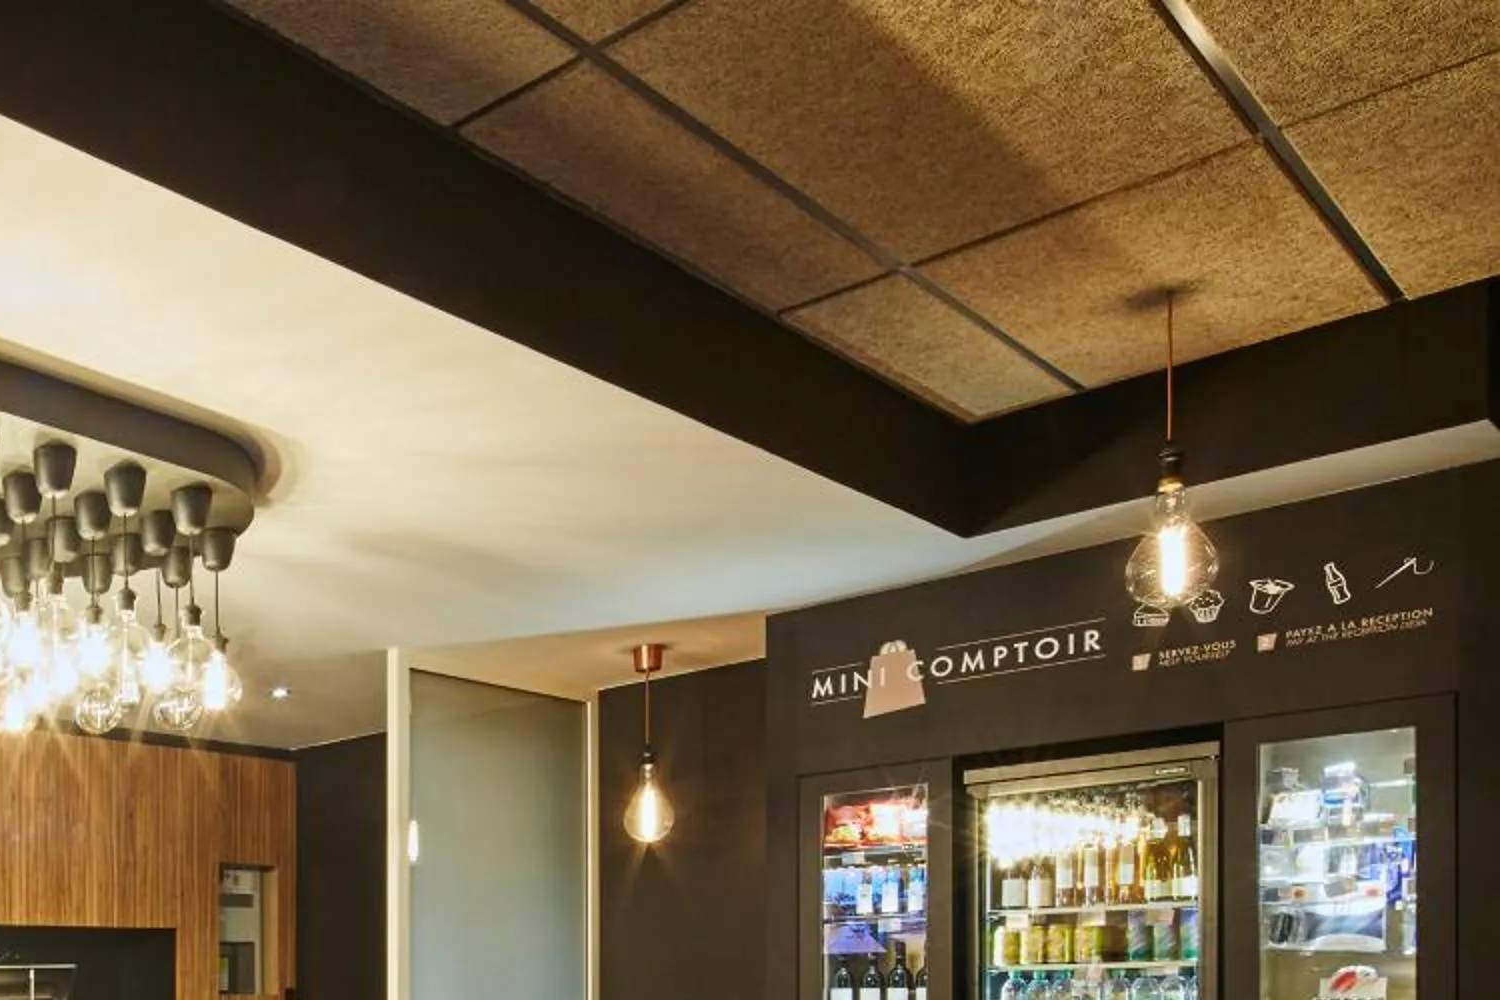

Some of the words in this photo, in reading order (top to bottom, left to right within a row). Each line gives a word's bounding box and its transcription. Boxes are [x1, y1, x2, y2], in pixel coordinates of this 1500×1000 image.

[1341, 618, 1358, 630] LA
[1361, 607, 1433, 627] RECEPTION
[811, 666, 886, 699] MINI
[906, 629, 1101, 682] COMPTOIR
